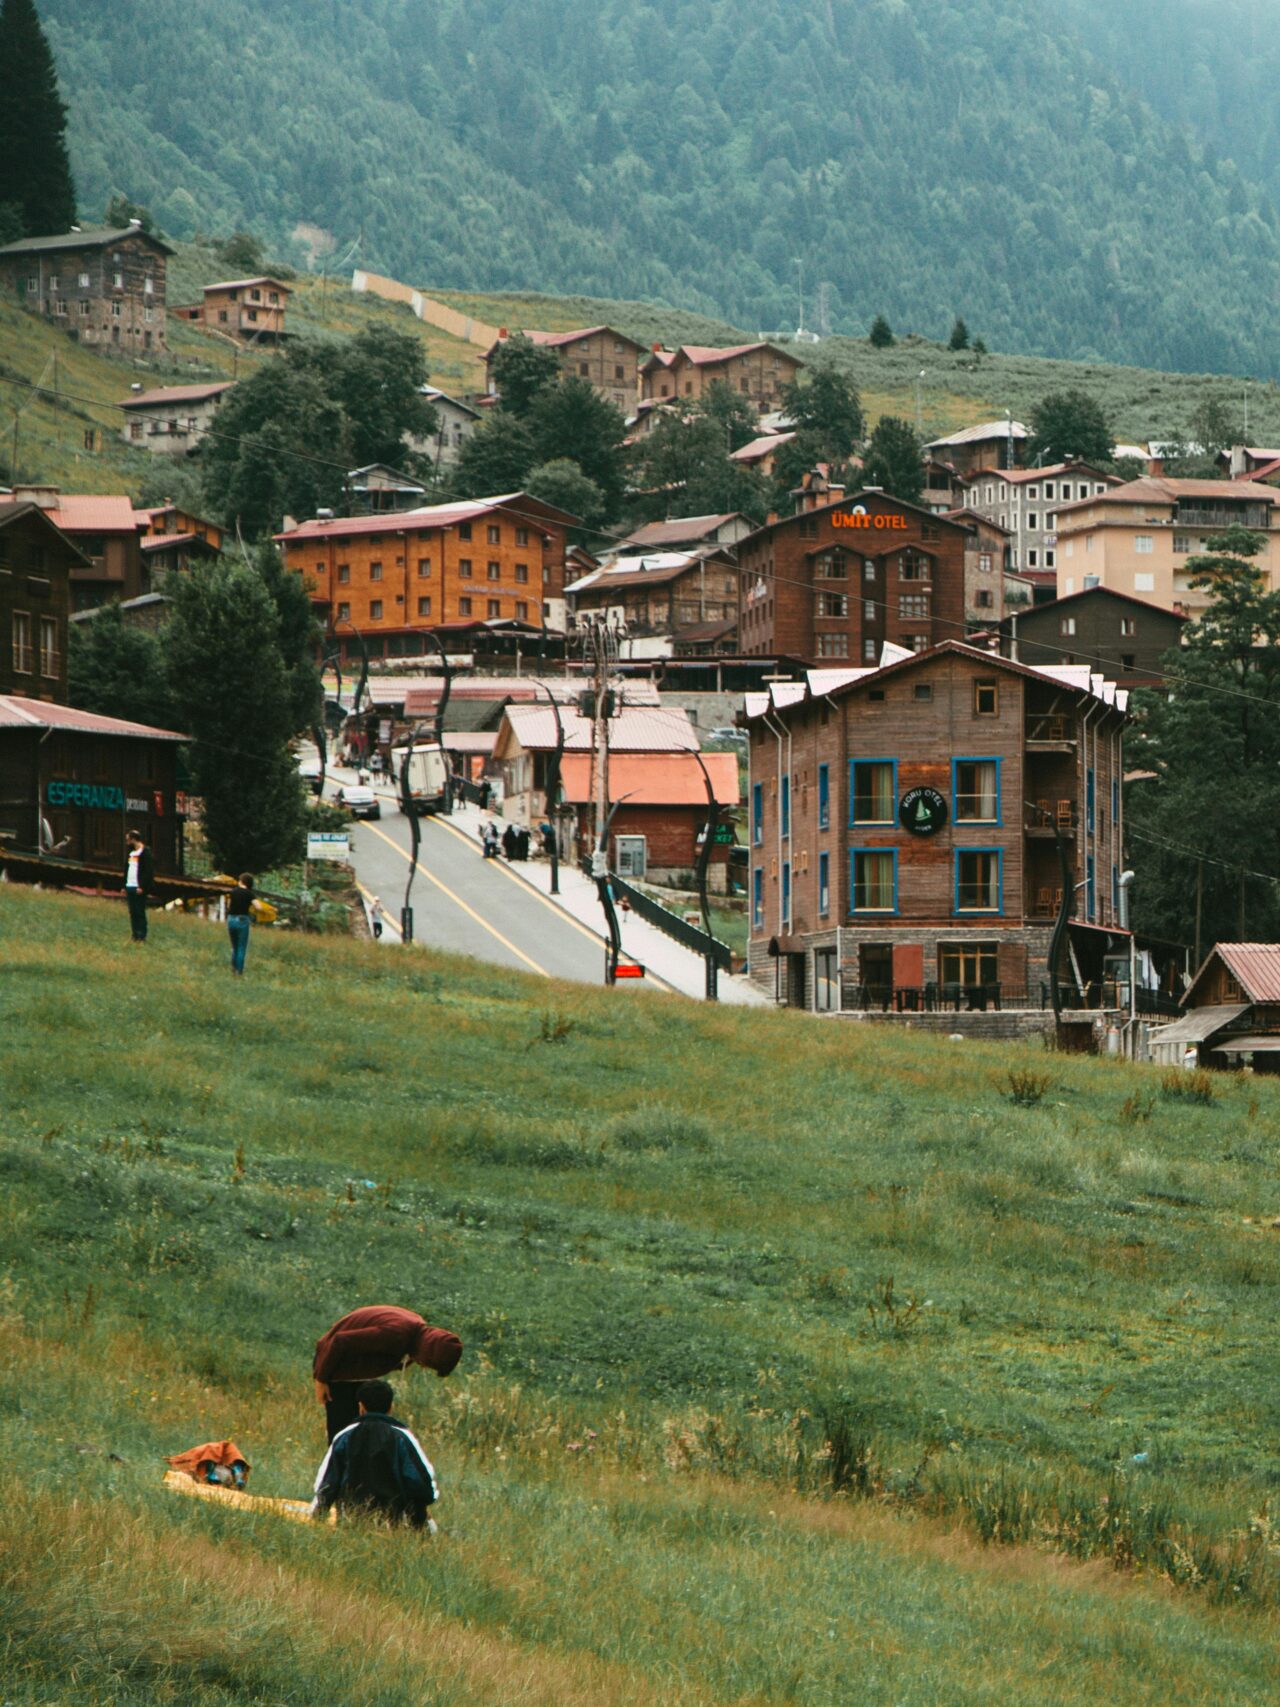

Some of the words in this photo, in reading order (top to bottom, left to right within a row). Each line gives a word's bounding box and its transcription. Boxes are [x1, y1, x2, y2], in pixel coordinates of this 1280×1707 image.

[874, 515, 908, 529] OTEL
[48, 782, 124, 810] ESPERANZA
[924, 789, 943, 807] OTEL
